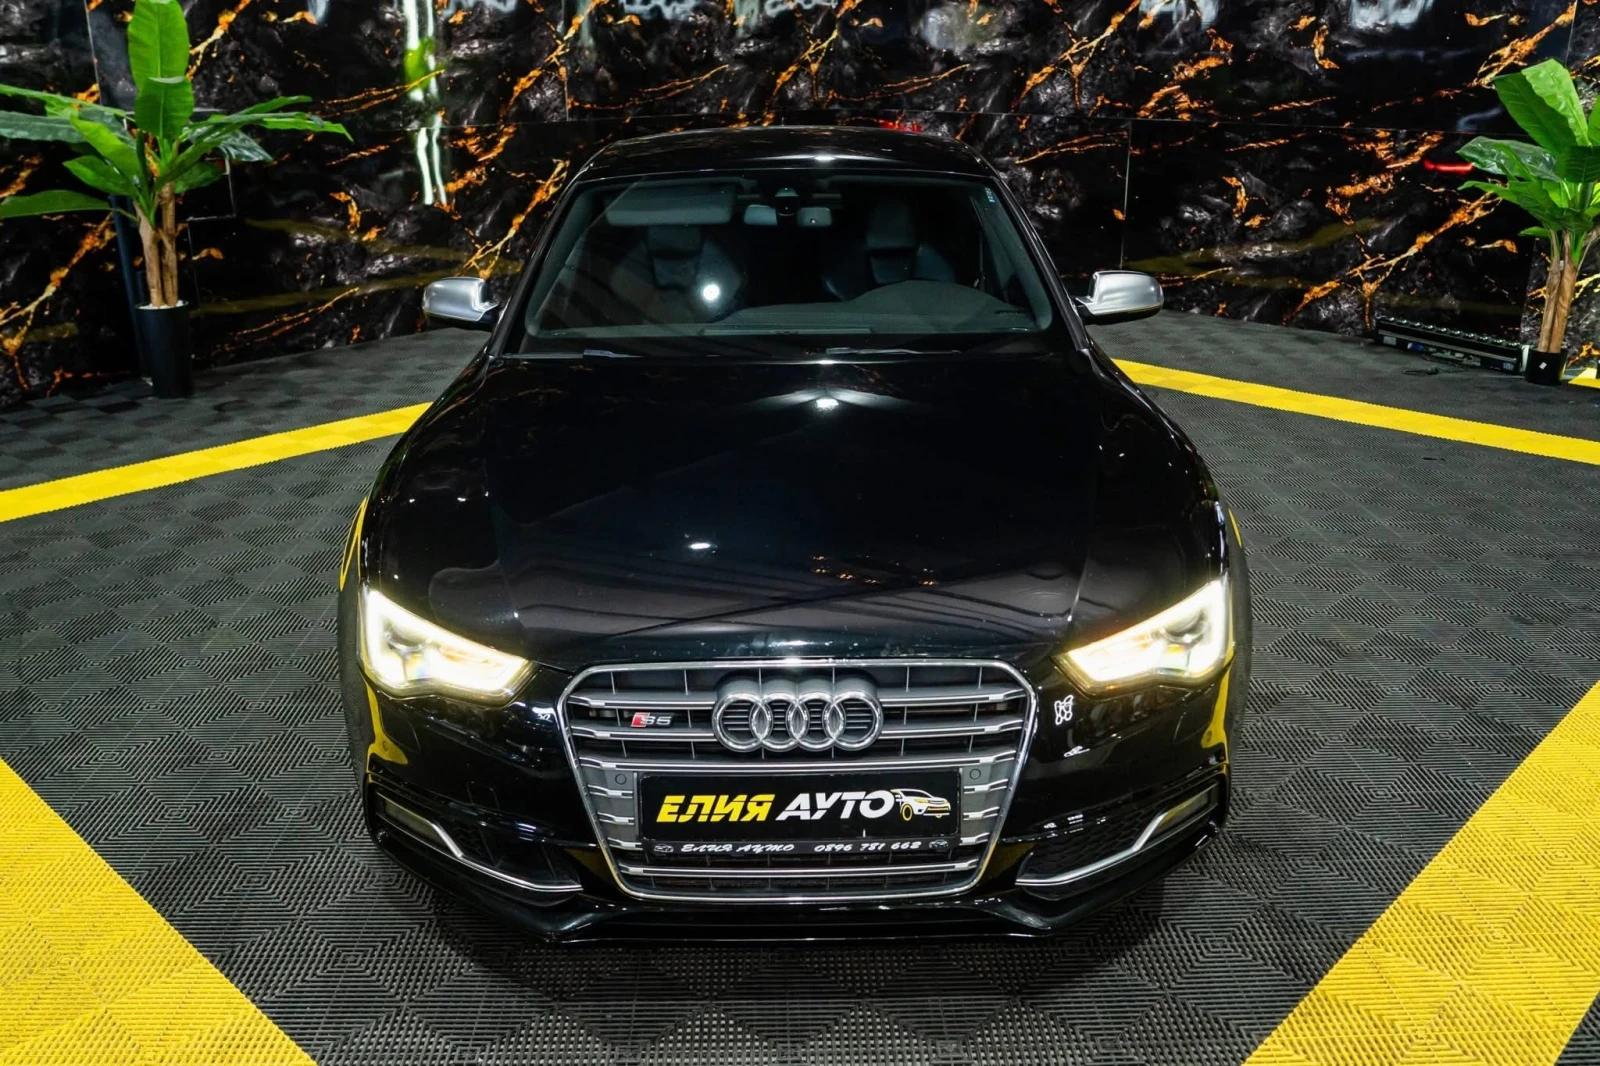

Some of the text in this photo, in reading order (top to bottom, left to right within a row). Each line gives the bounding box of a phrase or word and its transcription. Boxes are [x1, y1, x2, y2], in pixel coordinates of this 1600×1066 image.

[640, 714, 672, 727] S5
[656, 789, 895, 823] ЕЛИЯ АУТО
[813, 843, 854, 853] 0896
[859, 842, 886, 852] 781
